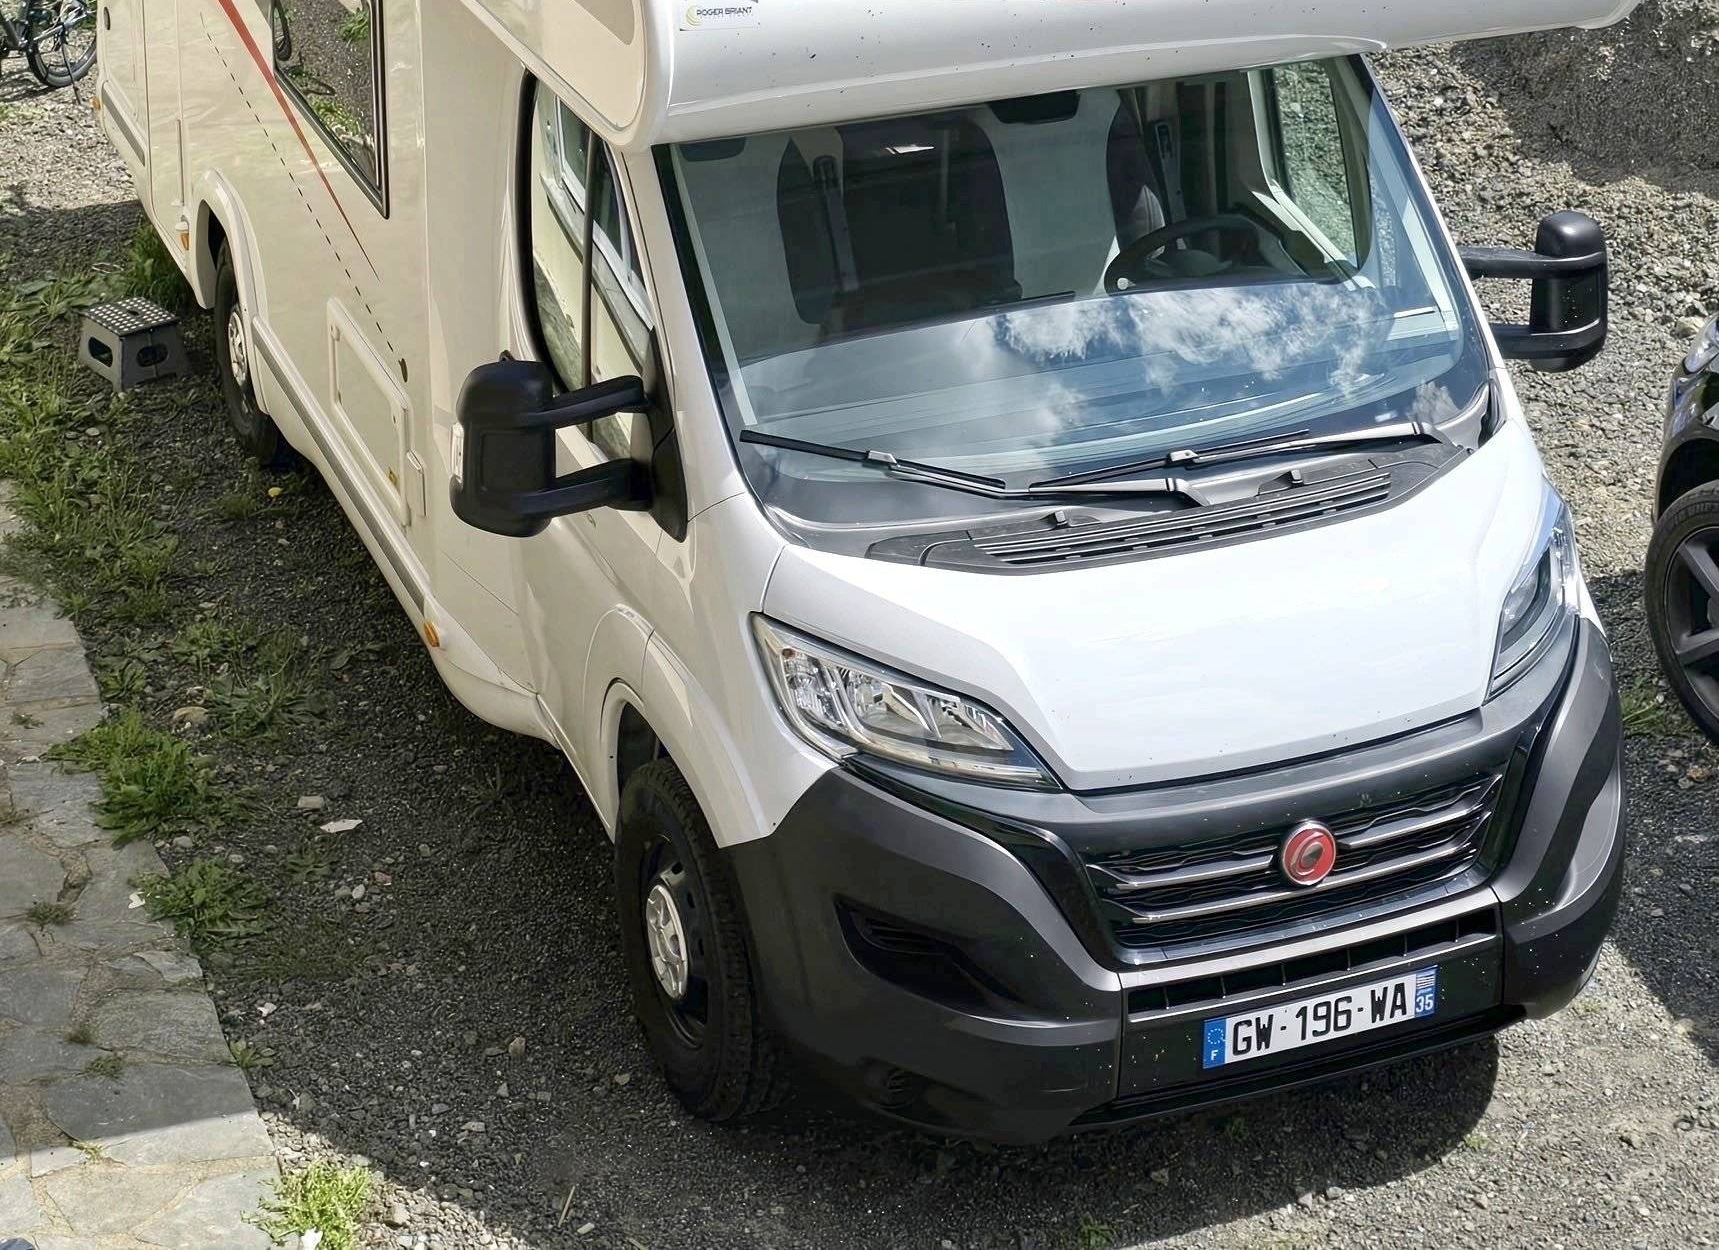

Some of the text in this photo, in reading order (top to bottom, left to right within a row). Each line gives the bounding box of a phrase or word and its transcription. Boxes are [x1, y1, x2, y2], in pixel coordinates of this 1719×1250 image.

[696, 8, 723, 16] ROGER
[1416, 994, 1434, 1012] 35
[1210, 1049, 1218, 1061] F
